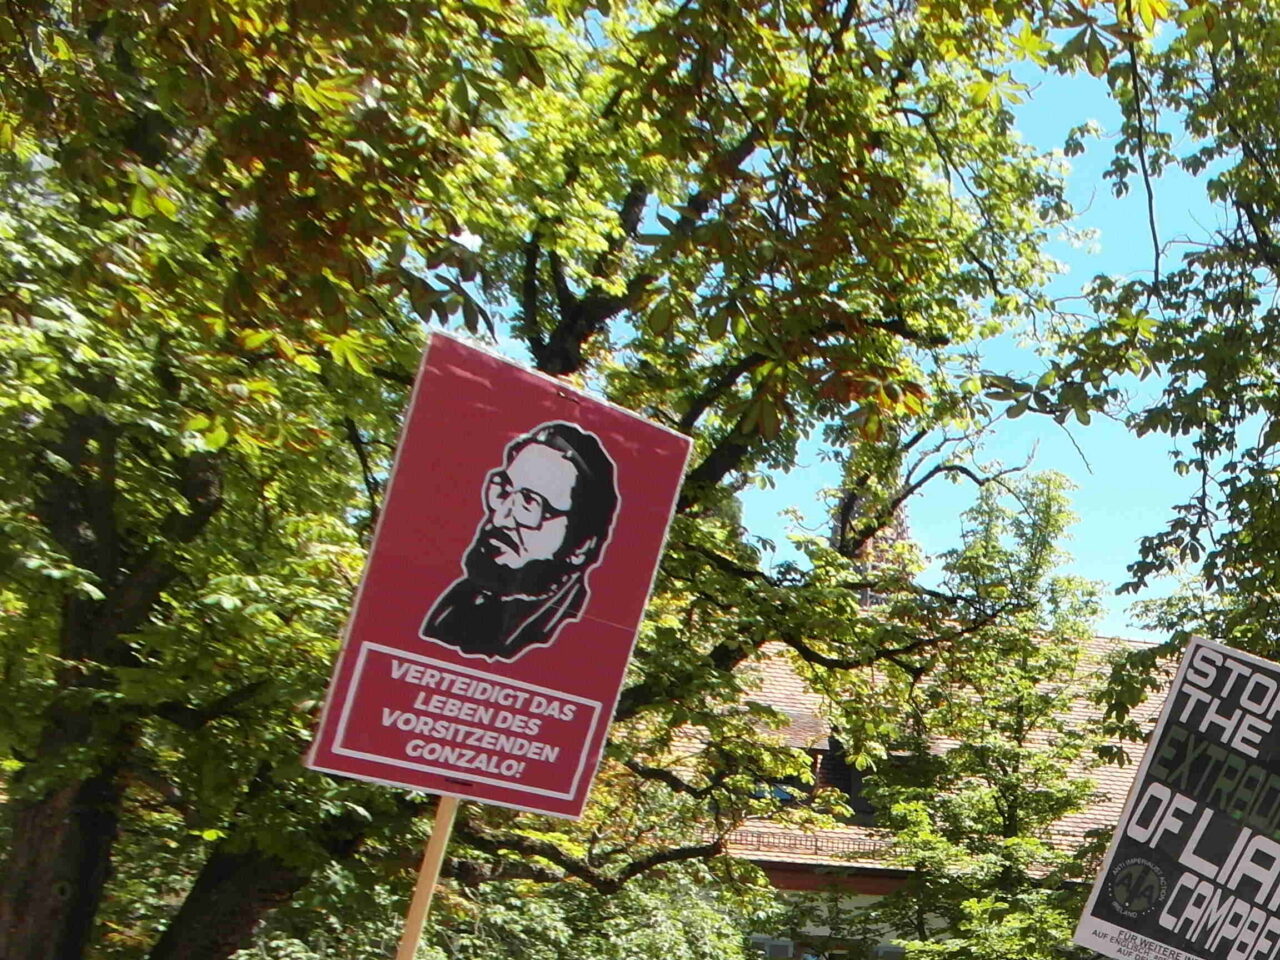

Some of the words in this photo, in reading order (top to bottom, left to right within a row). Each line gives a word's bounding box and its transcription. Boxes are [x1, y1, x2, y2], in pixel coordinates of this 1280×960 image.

[390, 659, 531, 710] VERTEIDIGT
[529, 696, 577, 721] DAS
[413, 692, 496, 725] LEBEN
[495, 711, 542, 736] DES
[381, 707, 559, 763] VORSITZENDEN
[1179, 683, 1272, 758] THE
[405, 739, 526, 778] GONZALO!
[1127, 782, 1197, 848] OF
[1092, 929, 1108, 941] AUF
[1117, 947, 1133, 959] AUF
